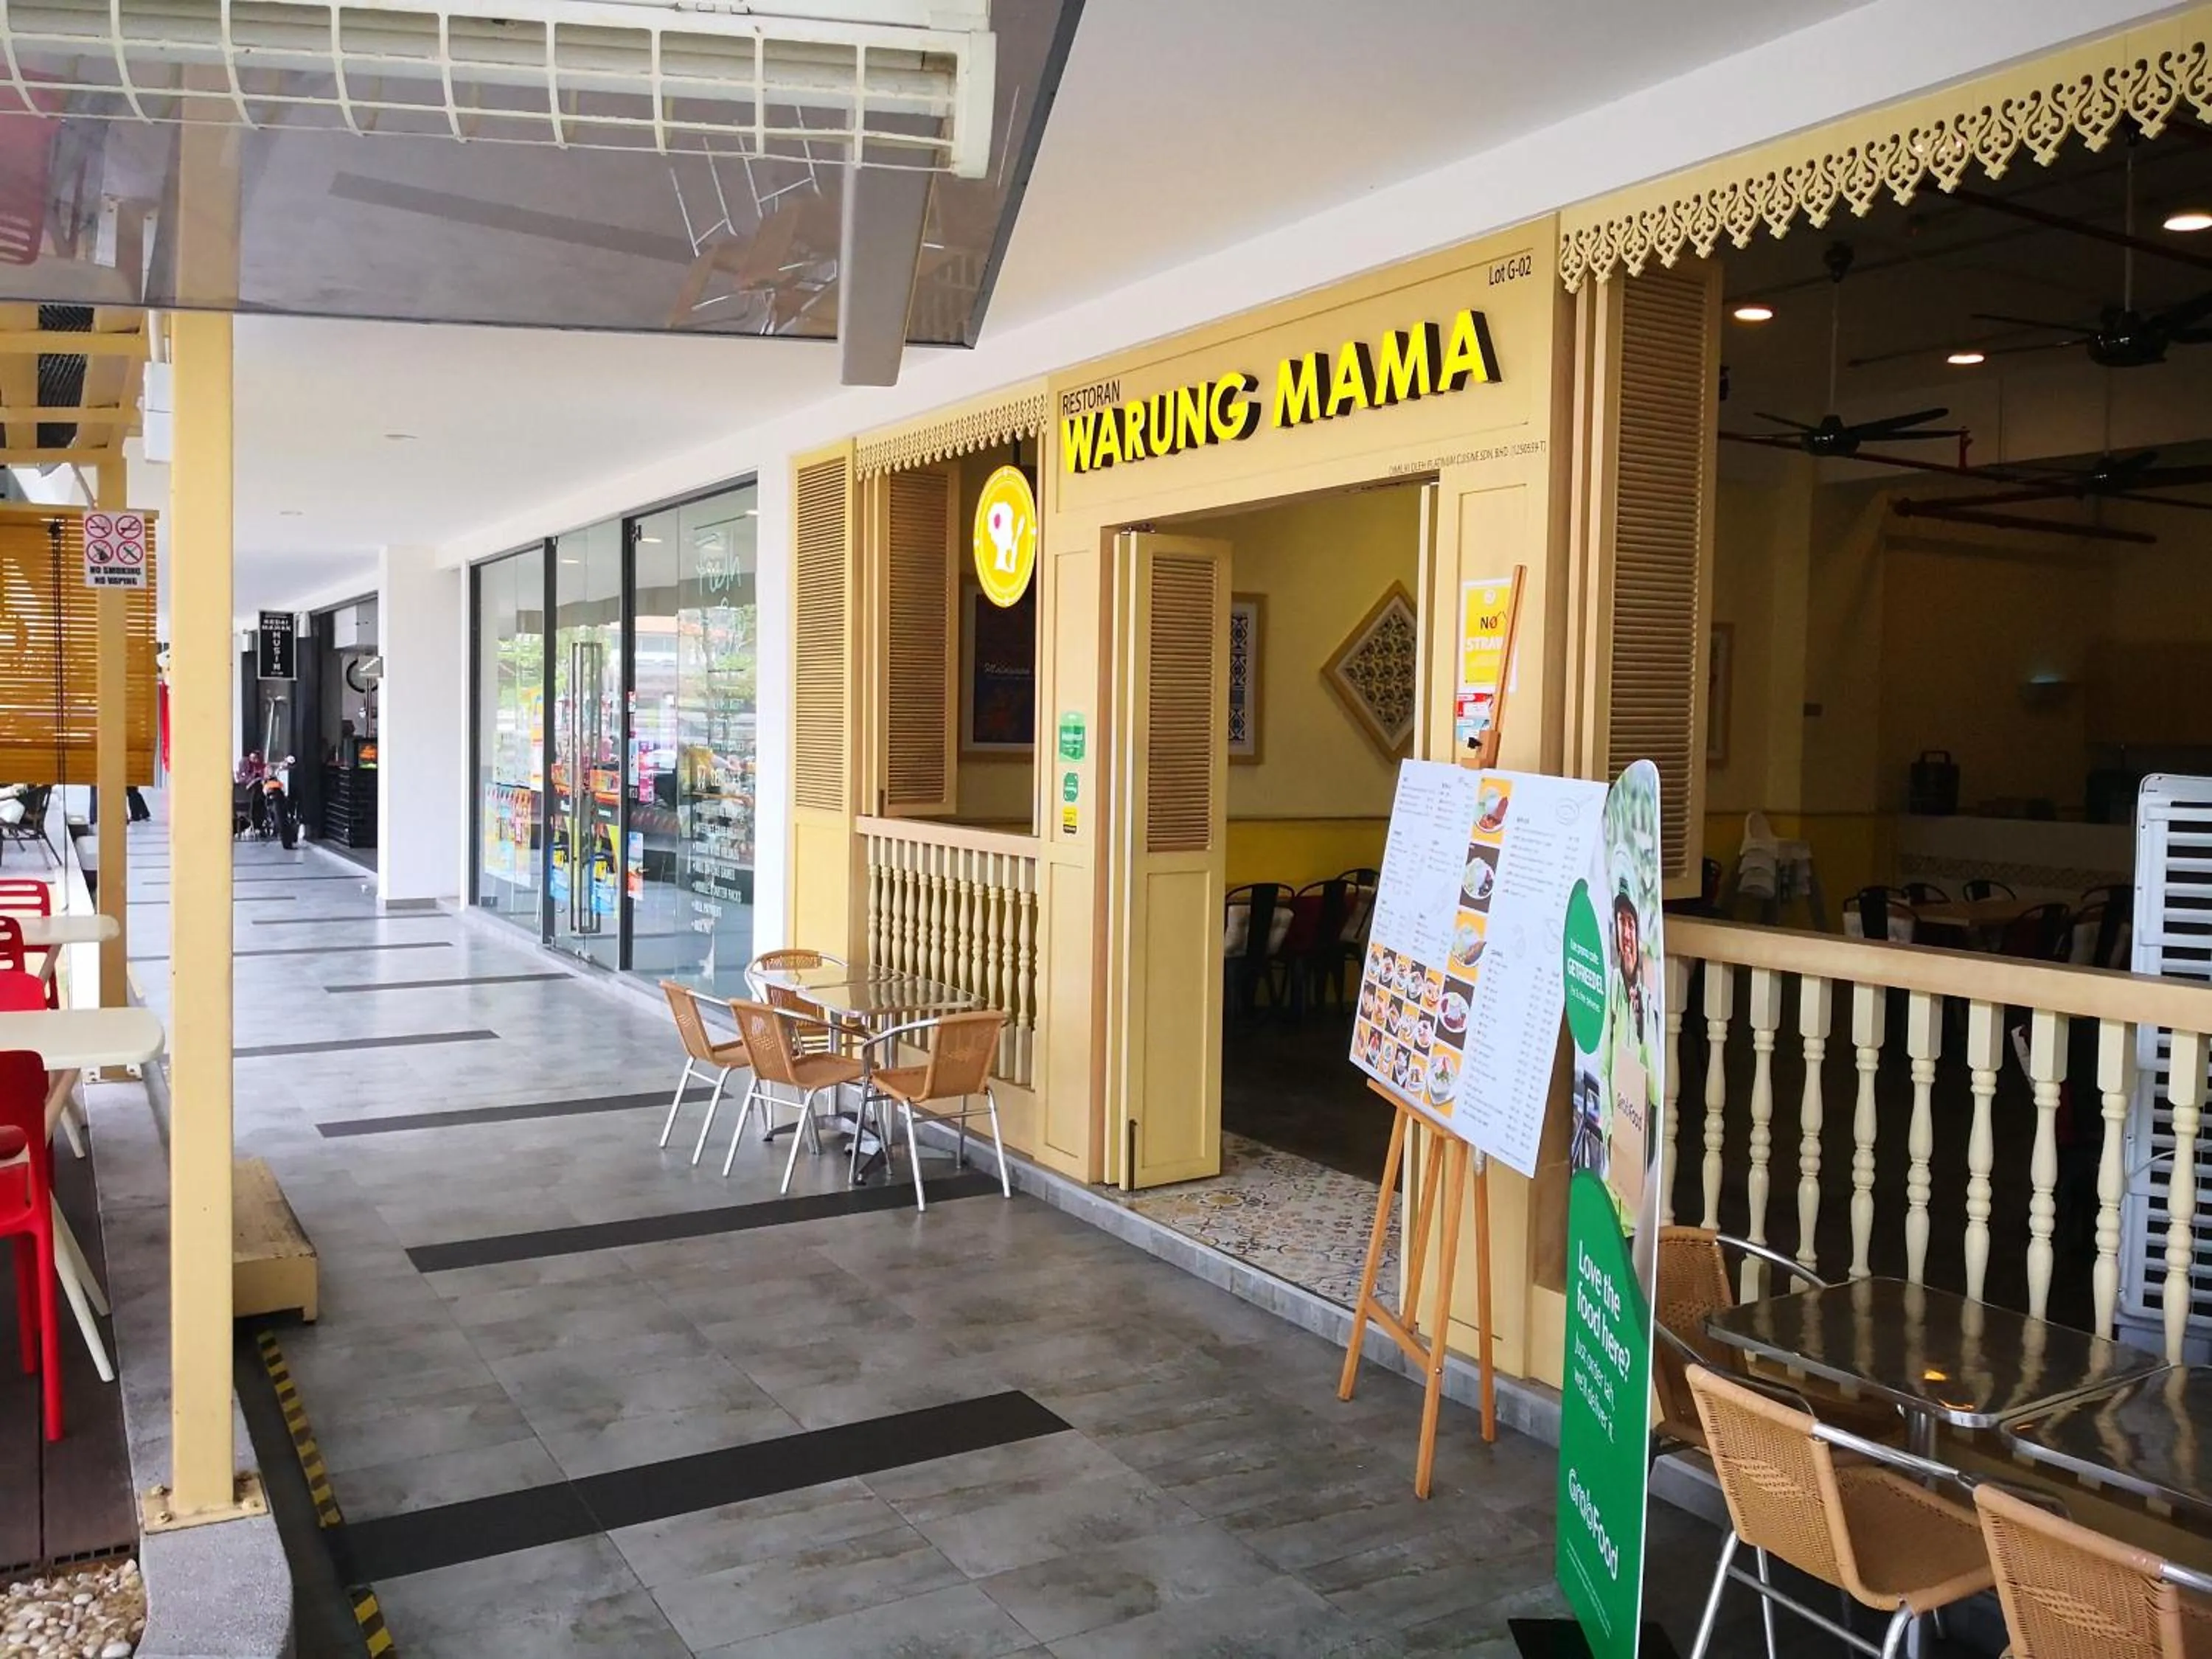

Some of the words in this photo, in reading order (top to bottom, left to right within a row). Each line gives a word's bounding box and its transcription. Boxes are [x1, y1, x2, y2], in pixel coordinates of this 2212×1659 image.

[1489, 265, 1505, 285] Lot
[1508, 255, 1531, 280] G-02
[1062, 372, 1258, 473] WARUNG
[1273, 308, 1500, 428] MAMA
[1062, 379, 1120, 417] RESTORAN
[103, 566, 141, 575] SMOKING
[108, 577, 138, 585] VAPING
[1579, 1239, 1601, 1296] Love
[1603, 1273, 1621, 1322] the
[1574, 1330, 1587, 1364] Just
[1587, 1354, 1604, 1388] order
[1577, 1280, 1601, 1340] food
[1601, 1312, 1630, 1383] here?
[1568, 1467, 1618, 1582] GrabFood
